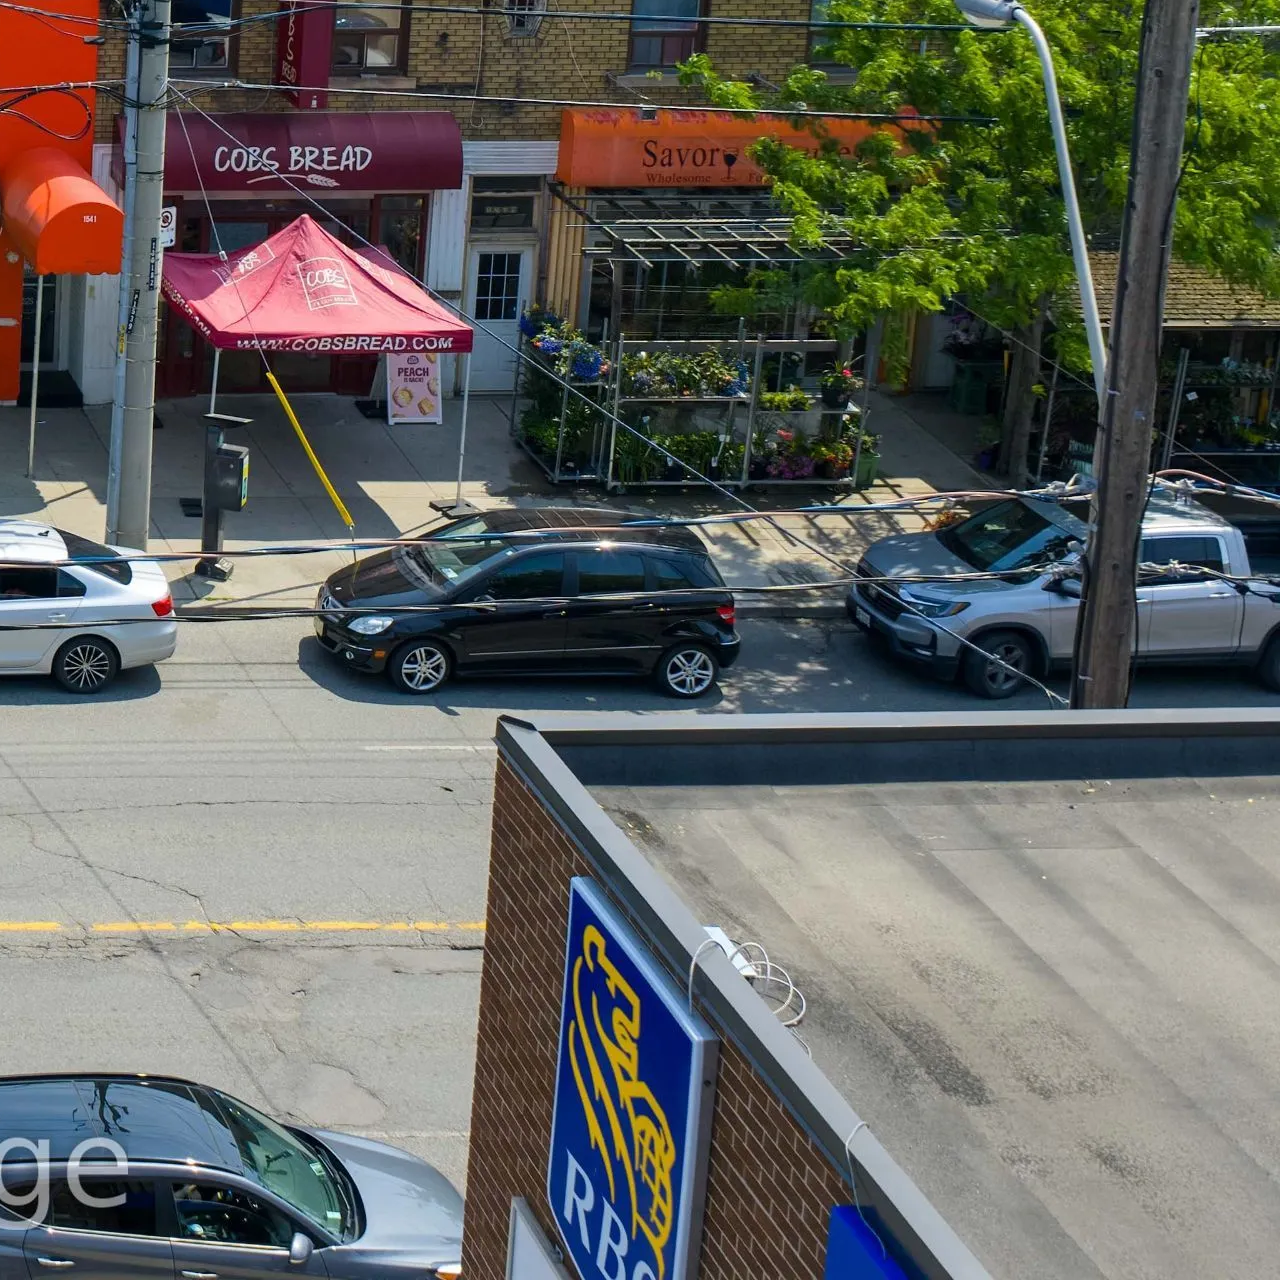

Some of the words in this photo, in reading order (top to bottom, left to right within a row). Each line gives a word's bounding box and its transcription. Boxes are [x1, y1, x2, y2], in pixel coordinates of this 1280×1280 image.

[214, 146, 280, 172] COBS
[288, 145, 373, 171] BREAD
[645, 173, 712, 184] Wholesome
[83, 215, 97, 223] 1541
[306, 268, 345, 287] COBS
[397, 367, 430, 377] PEACH
[562, 1147, 657, 1280] RB
